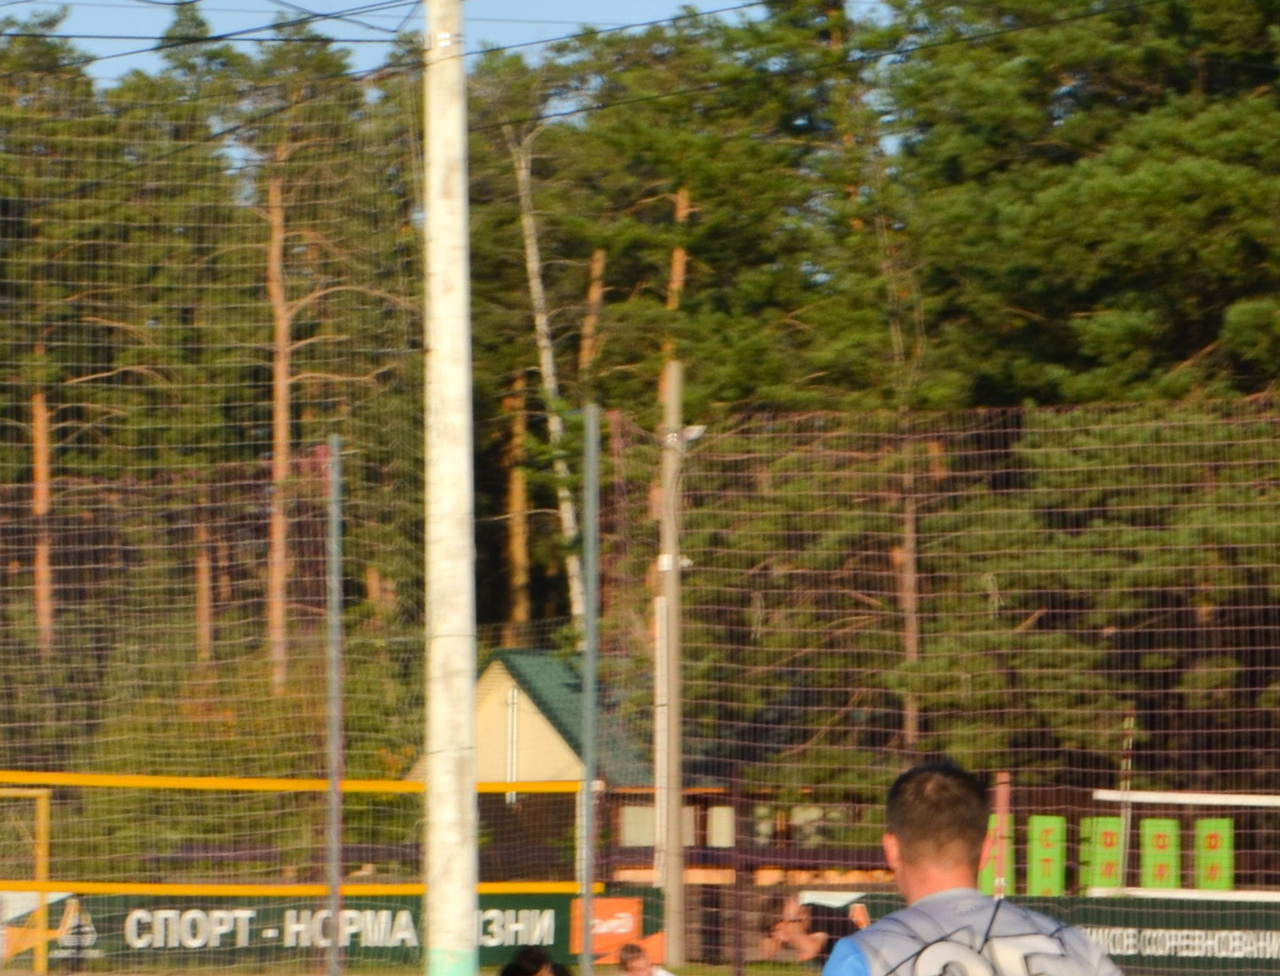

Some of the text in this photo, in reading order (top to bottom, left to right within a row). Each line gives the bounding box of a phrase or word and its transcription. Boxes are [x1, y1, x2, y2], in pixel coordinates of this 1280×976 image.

[124, 908, 257, 949] СПОРТ
[284, 909, 419, 947] НОРМА
[472, 908, 556, 946] ЗНИ
